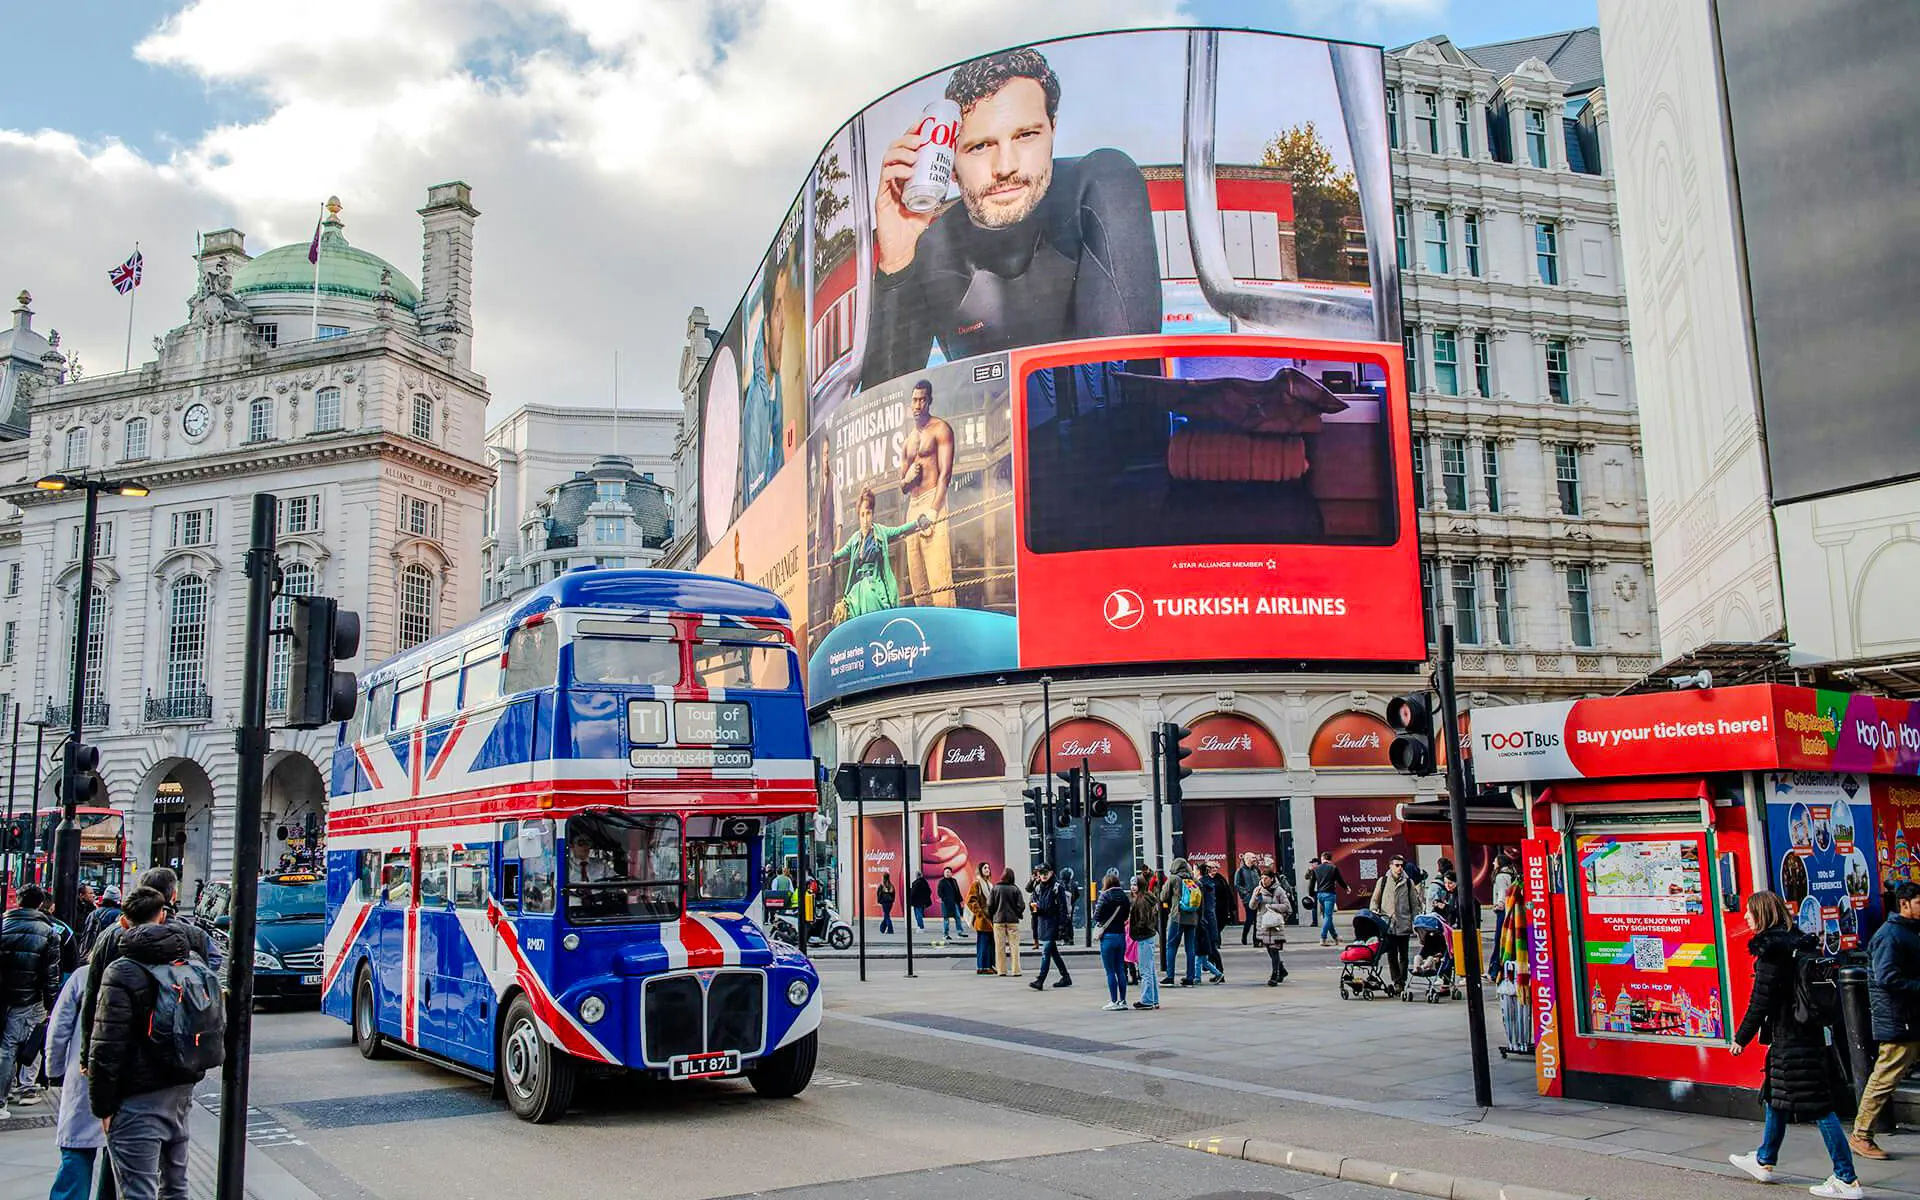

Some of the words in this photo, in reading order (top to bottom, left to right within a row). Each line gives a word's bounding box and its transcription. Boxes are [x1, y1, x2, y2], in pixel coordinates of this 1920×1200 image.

[930, 162, 938, 171] is
[936, 152, 951, 165] This
[843, 402, 905, 450] THOUSAND
[837, 432, 905, 491] BLOWS
[385, 467, 414, 484] ALLIANCE
[420, 480, 433, 490] LIFE
[437, 484, 456, 498] OFFICE
[1198, 561, 1231, 569] ALLIANCE
[1153, 597, 1249, 617] TURKISH
[1255, 597, 1346, 616] AIRLINES
[829, 649, 847, 665] Original
[847, 646, 865, 658] series
[839, 659, 865, 674] streaming
[685, 706, 716, 720] Tour
[723, 708, 739, 721] of
[687, 725, 739, 740] London
[1577, 729, 1608, 747] Buy
[1611, 728, 1651, 746] your
[1653, 721, 1715, 739] tickets
[1718, 715, 1768, 735] here!
[1856, 719, 1879, 750] Hop
[1881, 721, 1896, 749] On
[1899, 722, 1920, 752] Hop
[1057, 740, 1100, 756] Lindt
[1197, 735, 1240, 751] Lindt
[1332, 733, 1369, 748] Lindt
[1800, 734, 1828, 756] London
[944, 747, 977, 764] Lindt
[1352, 814, 1367, 822] look
[1367, 814, 1391, 822] forward
[1351, 827, 1371, 835] seeing
[1188, 852, 1226, 861] Indulgence
[1529, 856, 1545, 903] HERE
[1603, 917, 1625, 925] SCAN,
[1626, 917, 1642, 925] BUY,
[1532, 907, 1552, 981] TICKETS
[1537, 986, 1555, 1037] YOUR
[681, 1059, 707, 1074] WLT
[709, 1056, 730, 1071] 871
[1543, 1039, 1557, 1079] BUY
